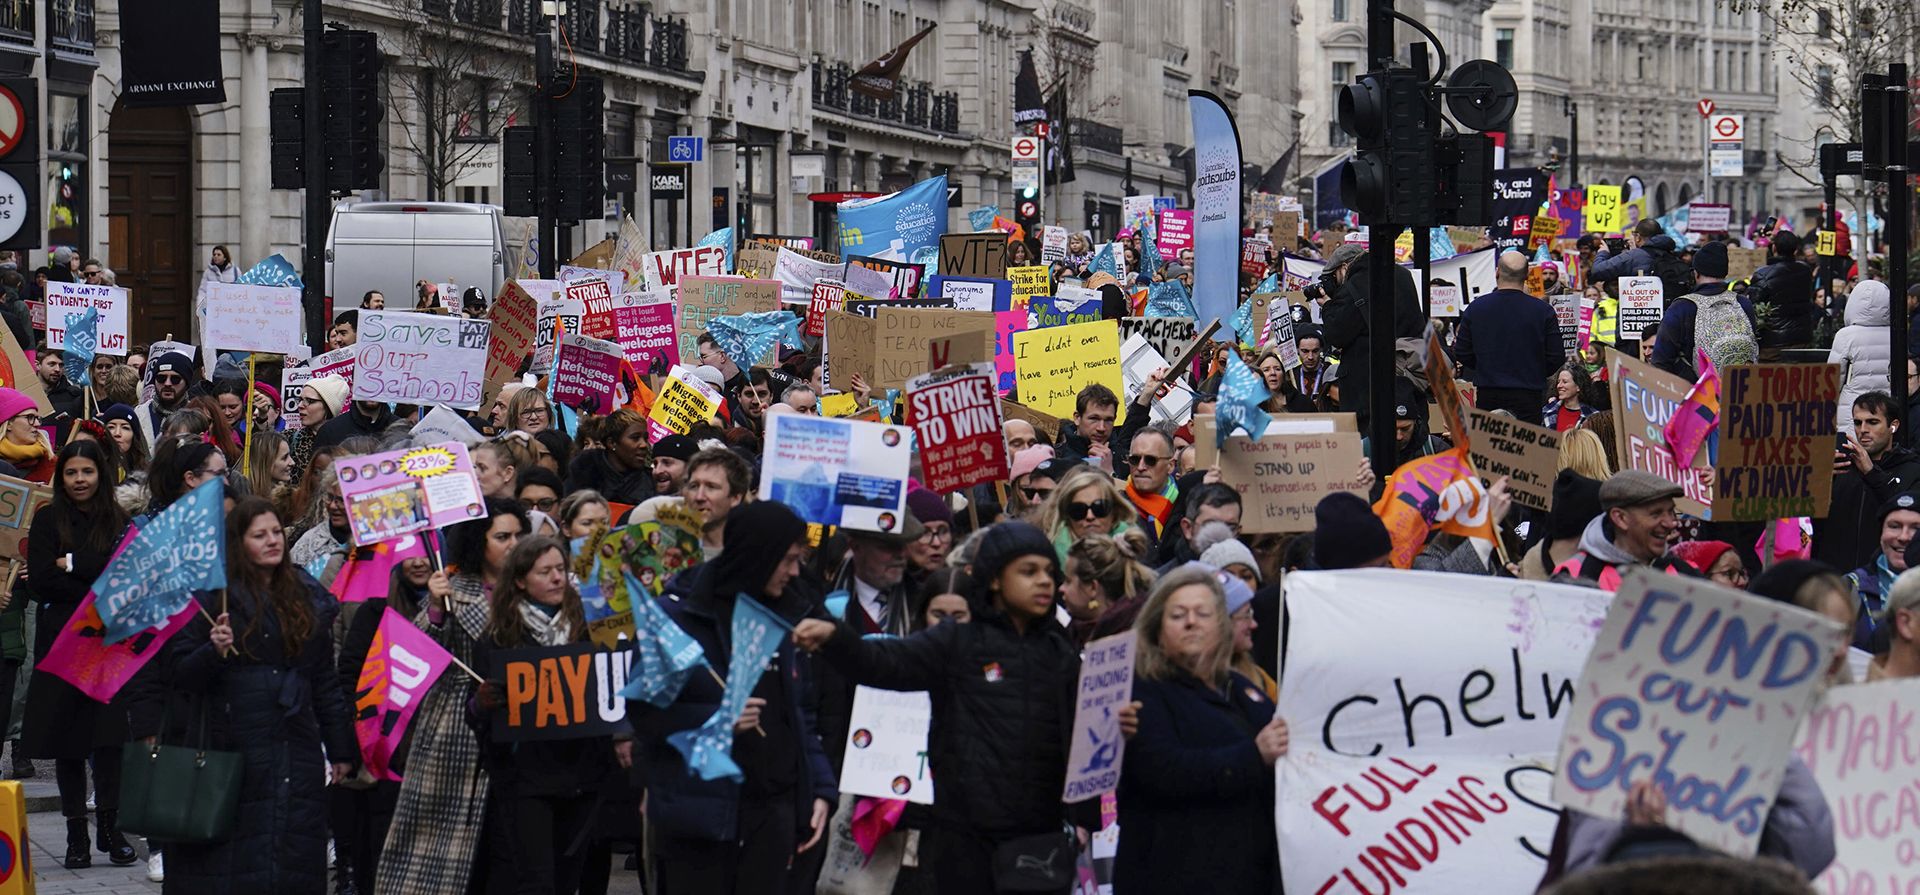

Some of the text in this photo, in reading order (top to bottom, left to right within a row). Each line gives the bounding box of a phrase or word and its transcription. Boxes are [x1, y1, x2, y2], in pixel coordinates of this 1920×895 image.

[128, 80, 216, 93] ARMANI EXCHANGE
[1700, 101, 1713, 114] V
[1038, 124, 1046, 136] L
[652, 175, 683, 186] KARL
[1512, 177, 1532, 188] and
[1503, 189, 1532, 199] Union
[1593, 189, 1617, 210] Pay
[895, 216, 937, 232] education
[1497, 216, 1530, 231] of LSE
[655, 247, 725, 286] WTF?
[942, 238, 1006, 276] WTF?
[1009, 274, 1047, 284] Strike for
[63, 285, 75, 294] YOU
[99, 287, 110, 296] PUT
[210, 288, 220, 300] I
[225, 289, 248, 300] used
[569, 283, 609, 300] STRIKE
[704, 282, 742, 306] HUFF
[744, 287, 758, 299] and
[945, 283, 984, 298] Synonyms
[958, 293, 971, 303] for
[1011, 285, 1048, 295] education
[48, 294, 113, 310] STUDENTS FIRST
[589, 297, 612, 315] WIN
[813, 299, 827, 313] TO
[616, 306, 655, 318] Say it loud
[618, 317, 632, 326] Say
[632, 316, 639, 324] it
[886, 313, 921, 330] DID
[933, 316, 956, 329] WE
[1033, 303, 1061, 325] You
[361, 314, 452, 347] Save
[461, 319, 487, 334] PAY
[501, 322, 529, 349] doing
[618, 323, 673, 339] Refugees
[1121, 319, 1195, 342] TEACHERS
[101, 332, 125, 349] LAST
[620, 336, 672, 350] welcome
[1018, 341, 1029, 359] I
[1081, 335, 1100, 345] even
[358, 343, 429, 372] Our
[622, 351, 650, 362] here
[560, 359, 615, 383] Refugees
[882, 358, 926, 379] NOT
[1020, 356, 1117, 381] have enough resources
[354, 370, 481, 402] Schools
[557, 382, 585, 396] here
[559, 373, 610, 394] welcome
[1730, 366, 1837, 404] IF TORIES
[663, 388, 671, 400] &
[671, 381, 709, 413] Migrants
[912, 378, 991, 421] STRIKE
[1026, 385, 1076, 407] to finish
[1624, 378, 1682, 429] FUN
[666, 416, 686, 434] here
[916, 416, 948, 449] TO
[950, 405, 997, 440] WIN
[1470, 412, 1537, 444] THOSE WHO
[1728, 400, 1837, 440] PAID THEIR
[927, 439, 977, 464] We all need
[1273, 442, 1288, 457] my
[1294, 440, 1321, 454] pupils
[1325, 439, 1338, 449] to
[1489, 437, 1525, 456] TEACH.
[1740, 436, 1812, 467] TAXES
[405, 454, 446, 471] 23%
[937, 461, 953, 475] pay
[955, 456, 973, 468] rise
[1254, 462, 1315, 476] STAND UP
[1491, 460, 1510, 477] WHO
[1629, 434, 1713, 507] FUTURE
[932, 466, 999, 492] Strike together
[1260, 481, 1345, 494] themselves and
[1719, 465, 1814, 499] WE'D HAVE
[1265, 502, 1300, 520] it's my
[1619, 588, 1820, 690] FUND
[1089, 642, 1127, 668] FIX THE
[506, 653, 591, 728] PAY
[595, 650, 633, 723] U
[1082, 666, 1130, 693] FUNDING
[1115, 690, 1125, 701] BE
[1797, 700, 1920, 780] MAK
[1566, 695, 1768, 836] Schools
[1066, 770, 1117, 798] FINISHED
[1311, 756, 1438, 837] FULL
[1313, 775, 1508, 895] FUNDING
